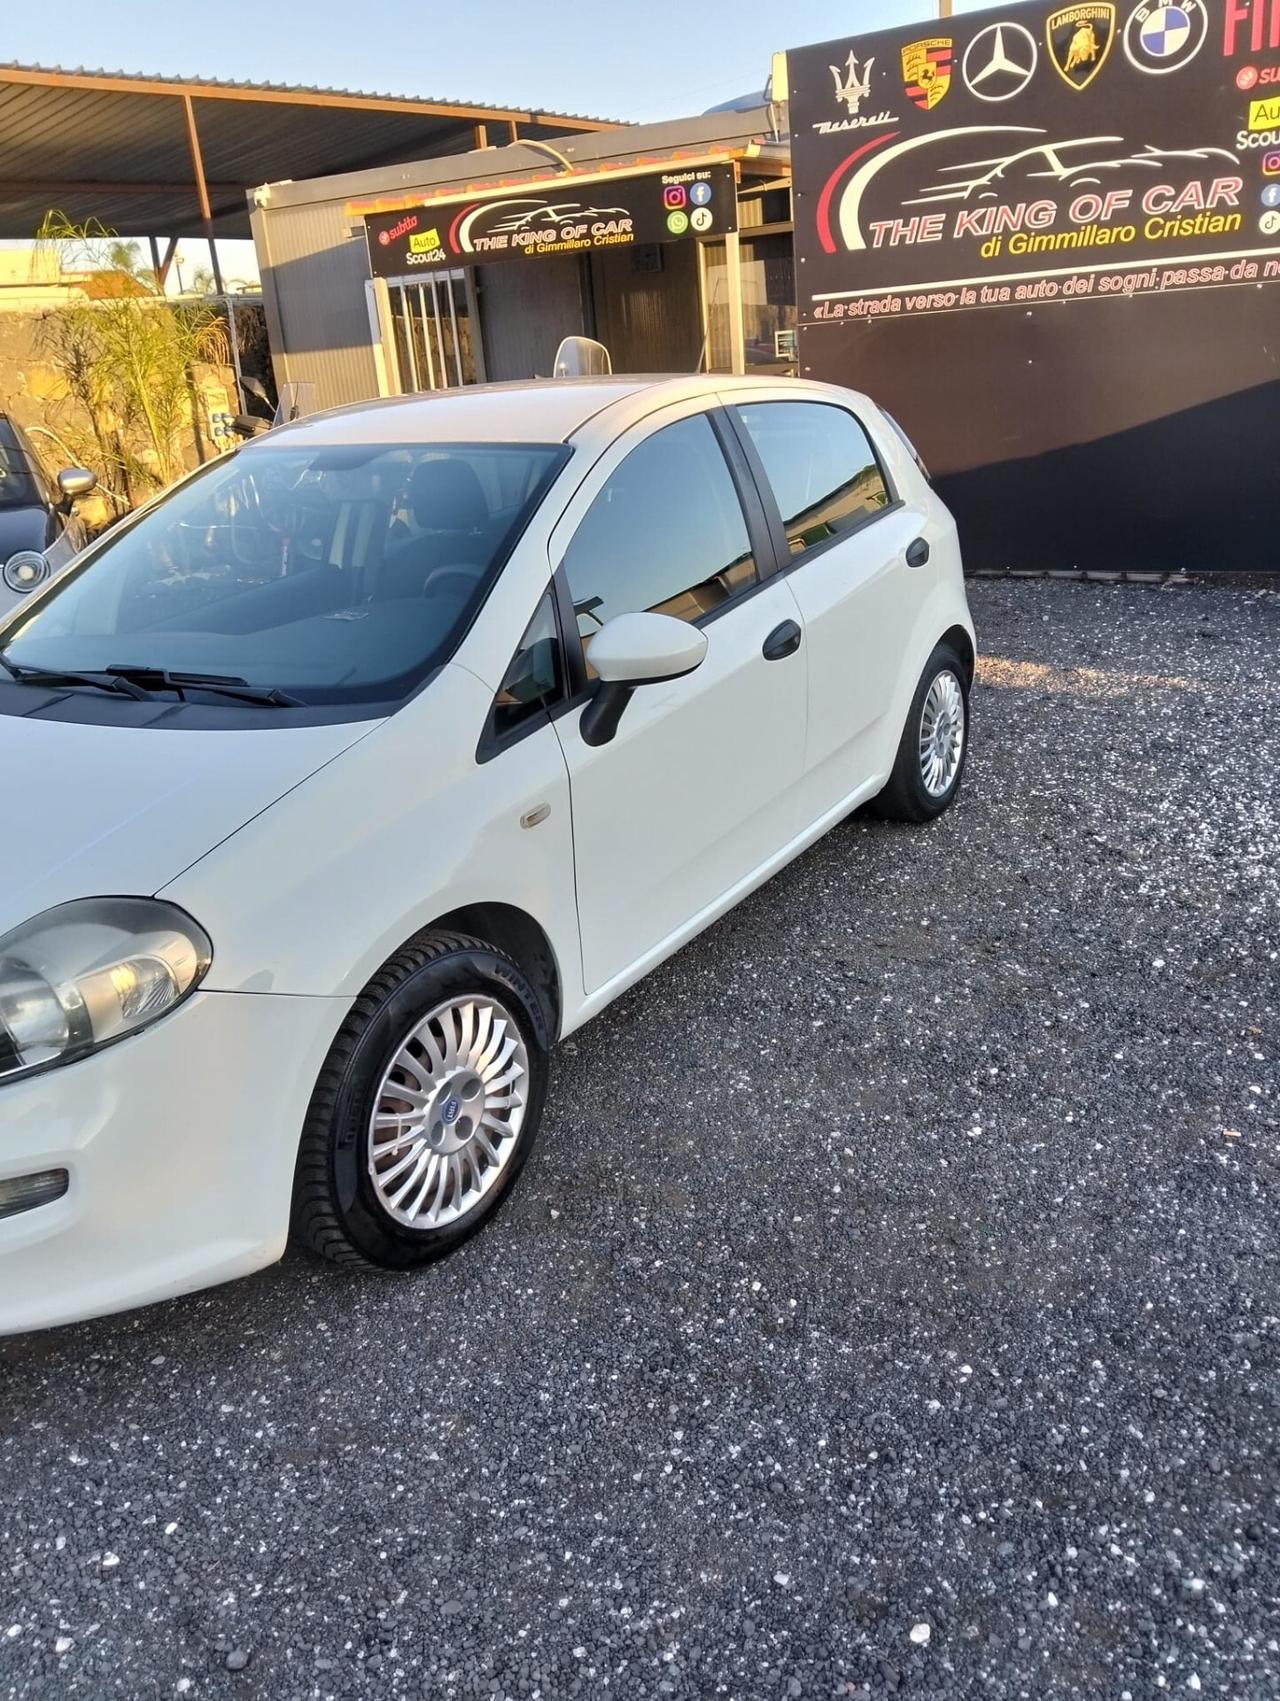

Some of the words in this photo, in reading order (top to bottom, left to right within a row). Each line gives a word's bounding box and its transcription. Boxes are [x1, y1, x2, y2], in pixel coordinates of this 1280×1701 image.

[1051, 8, 1110, 30] LAMBORGHINI
[1135, 0, 1197, 22] BMW
[902, 39, 951, 55] PORSCHE
[812, 110, 900, 134] Maserati
[661, 172, 696, 184] Seguici
[696, 171, 712, 180] su:
[869, 214, 946, 248] THE
[953, 200, 1057, 238] KING
[1068, 189, 1133, 224] OF
[1141, 176, 1244, 214] CAR
[389, 216, 418, 240] subito
[473, 235, 508, 251] THE
[512, 229, 557, 246] KING
[560, 224, 588, 240] OF
[591, 218, 633, 236] CAR
[980, 234, 1001, 258] di
[1009, 222, 1136, 255] Gimmillaro
[1143, 210, 1242, 239] Cristian
[413, 237, 437, 249] Auto
[524, 243, 534, 255] di
[537, 238, 592, 253] Gimmillaro
[594, 232, 634, 246] Cristian
[406, 248, 447, 265] Scout24
[848, 297, 902, 316] strada
[905, 293, 957, 310] verso
[959, 287, 977, 305] la
[980, 285, 1011, 303] tua
[1015, 280, 1059, 300] auto
[1062, 274, 1095, 295] dei
[1098, 267, 1158, 294] sogni
[1160, 264, 1226, 291] passa
[1230, 259, 1259, 279] da
[1263, 260, 1280, 277] n
